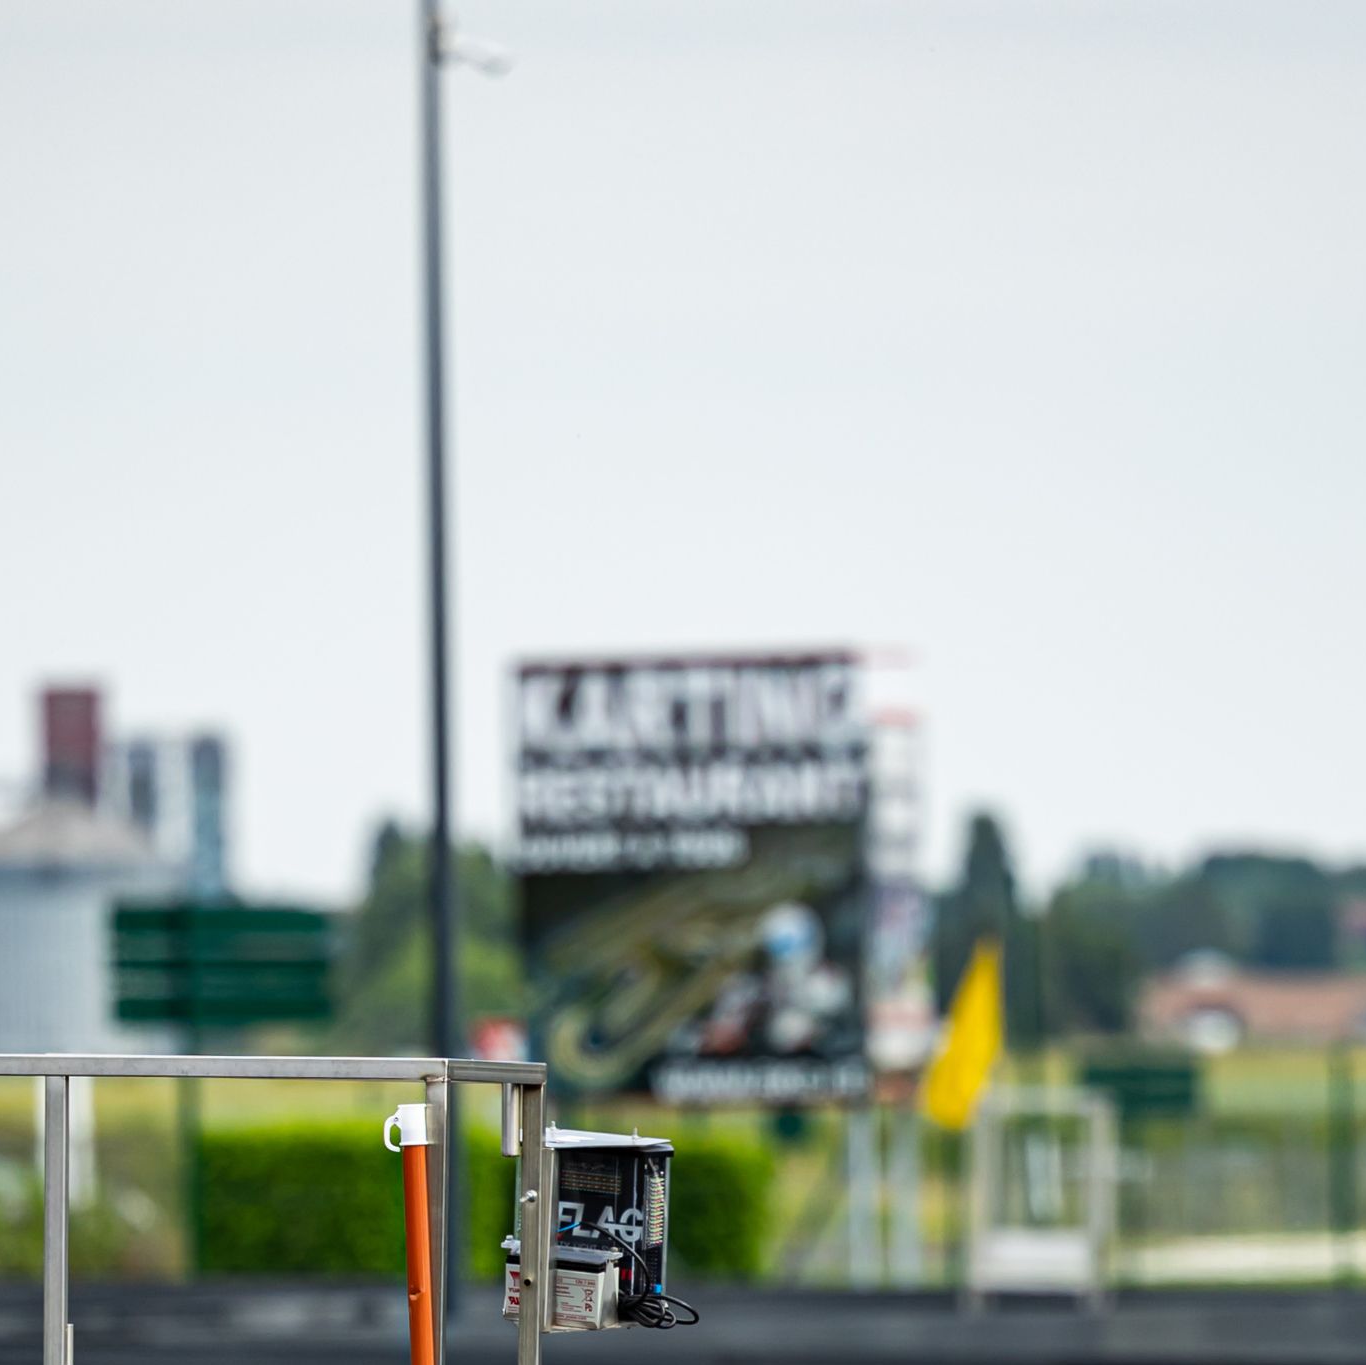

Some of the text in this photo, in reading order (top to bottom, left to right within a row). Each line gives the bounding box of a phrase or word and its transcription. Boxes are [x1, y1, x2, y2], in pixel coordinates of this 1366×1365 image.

[521, 668, 857, 748] KARTING
[522, 762, 864, 820] RESTAURANT
[557, 1200, 644, 1243] FLAG
